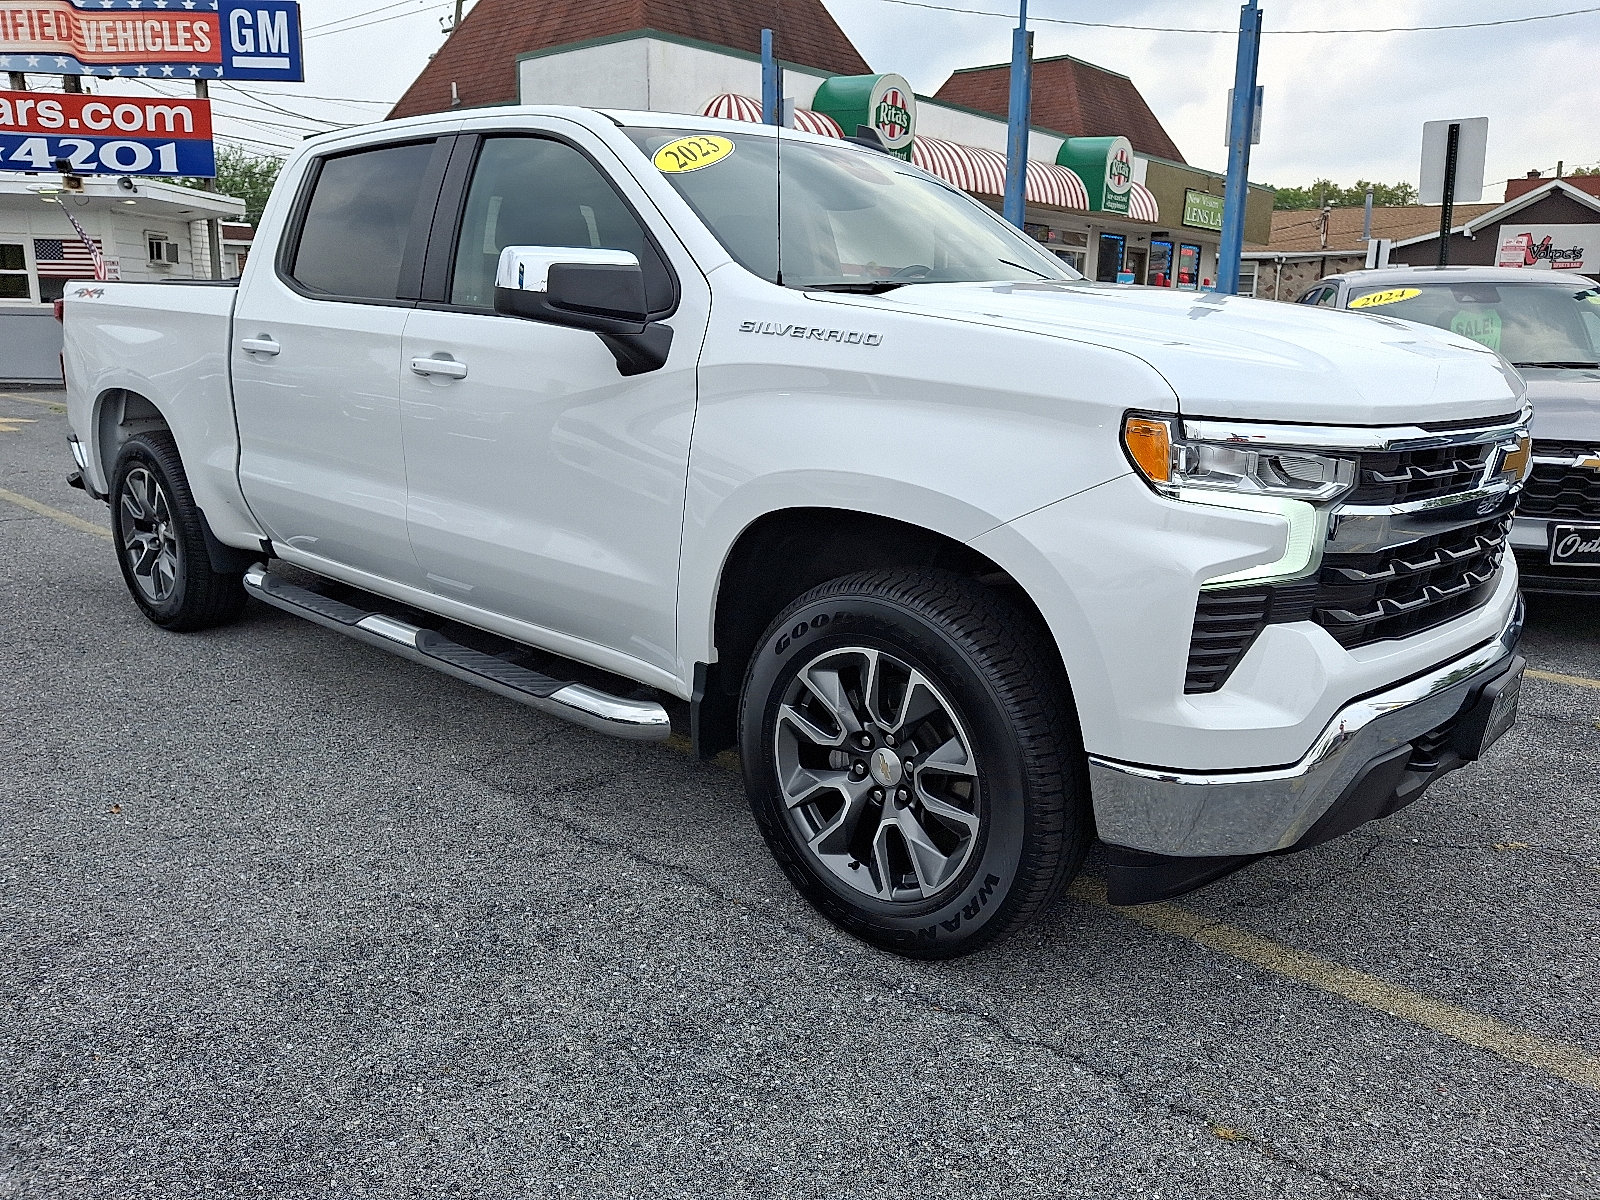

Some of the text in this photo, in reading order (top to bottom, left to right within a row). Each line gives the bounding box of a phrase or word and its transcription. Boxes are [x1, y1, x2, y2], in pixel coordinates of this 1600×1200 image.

[0, 9, 212, 53] IFIED VEHICLES
[229, 8, 290, 54] GM
[0, 98, 194, 133] ars.com
[880, 101, 908, 128] Rita's
[8, 137, 179, 174] 4201
[664, 137, 720, 169] 2023
[1111, 158, 1130, 178] Rita's
[1187, 193, 1201, 204] New
[1186, 206, 1209, 224] LENS
[1527, 244, 1584, 263] Volpe's
[1361, 289, 1406, 307] 2024
[739, 321, 883, 346] SILVERADO
[1456, 318, 1493, 336] SALE!
